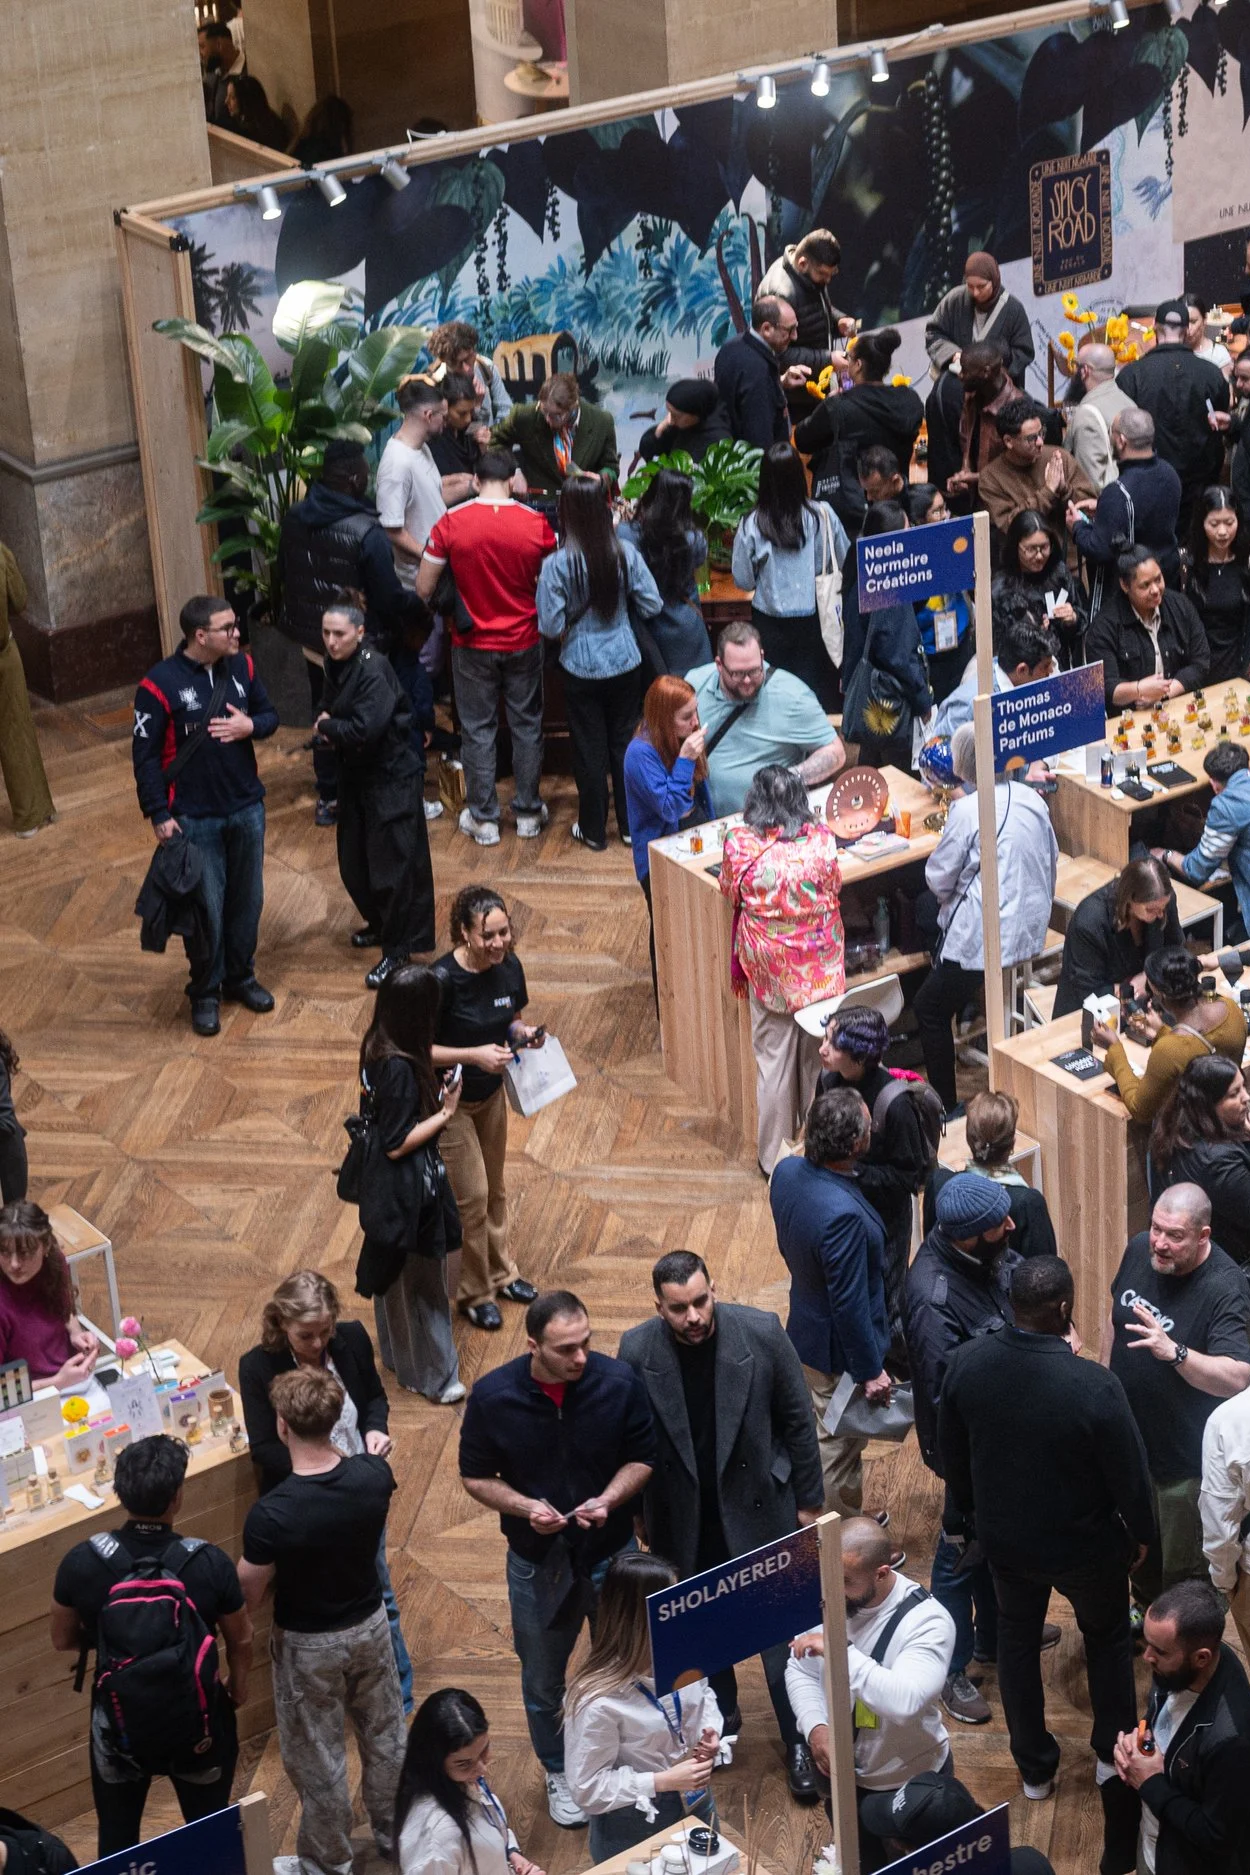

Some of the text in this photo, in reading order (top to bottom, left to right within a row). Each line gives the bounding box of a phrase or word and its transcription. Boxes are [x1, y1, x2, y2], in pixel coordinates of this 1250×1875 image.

[1050, 173, 1092, 220] SPICY
[1219, 205, 1234, 218] UNE
[1048, 211, 1096, 253] ROAD
[864, 541, 904, 560] Neela
[864, 553, 929, 577] Vermeire
[865, 569, 933, 593] Créations
[997, 690, 1051, 717] Thomas
[998, 702, 1072, 735] de Monaco
[1000, 726, 1055, 753] Parfums
[658, 1551, 792, 1622] SHOLAYERED
